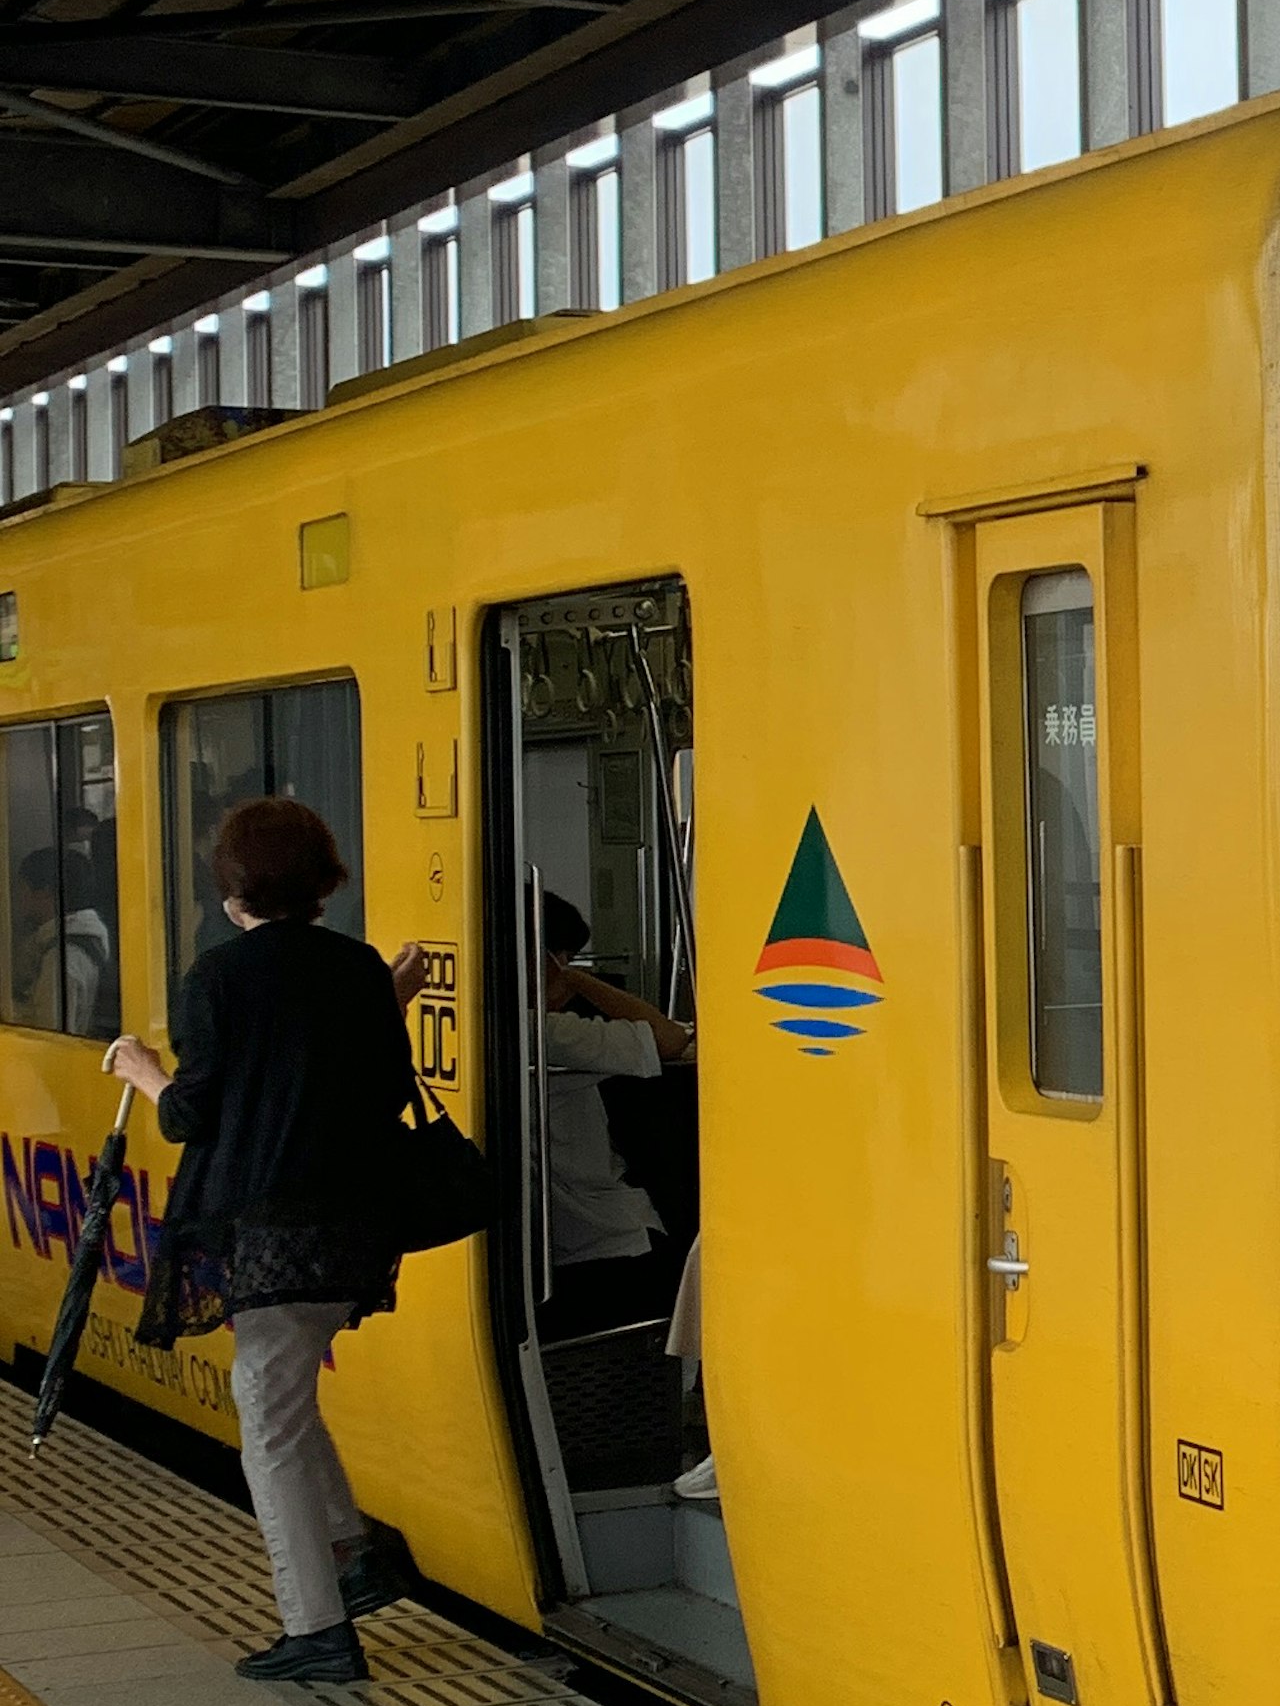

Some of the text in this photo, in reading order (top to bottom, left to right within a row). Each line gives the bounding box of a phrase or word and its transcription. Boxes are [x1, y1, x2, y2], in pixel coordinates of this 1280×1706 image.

[1044, 704, 1096, 747] 乗務員
[420, 1003, 456, 1081] DC
[1181, 1451, 1220, 1499] DK SK
